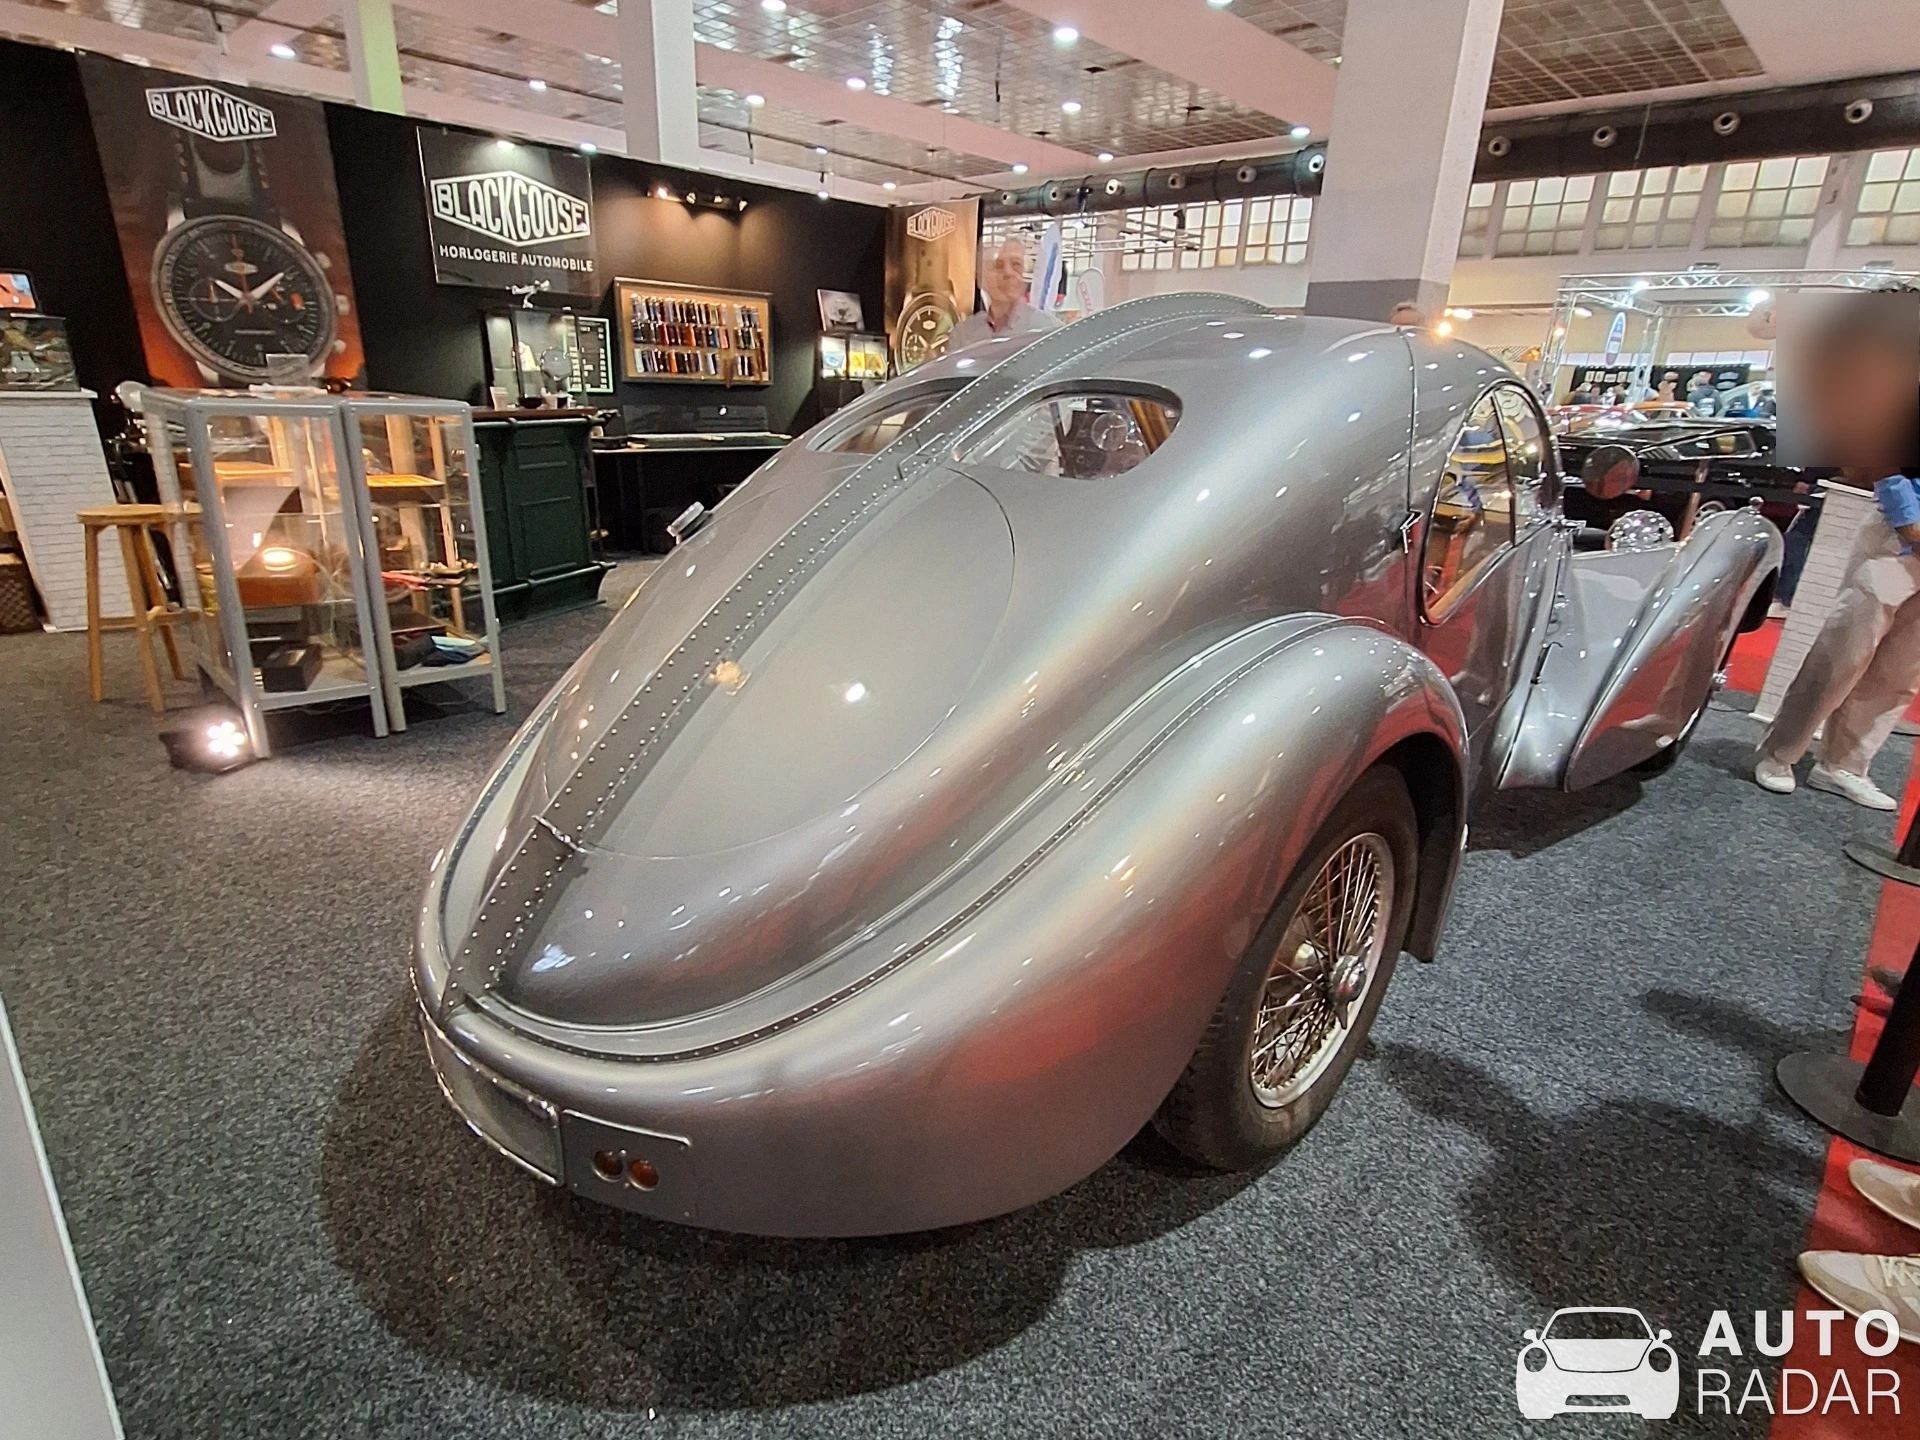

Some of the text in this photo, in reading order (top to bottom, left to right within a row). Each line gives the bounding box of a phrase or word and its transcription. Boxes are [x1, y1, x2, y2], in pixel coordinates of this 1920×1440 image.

[151, 89, 273, 136] BLACKGOOSE
[436, 175, 587, 241] BLACKGOOSE
[439, 244, 593, 272] HORLOGERIE AUTOMOBILE
